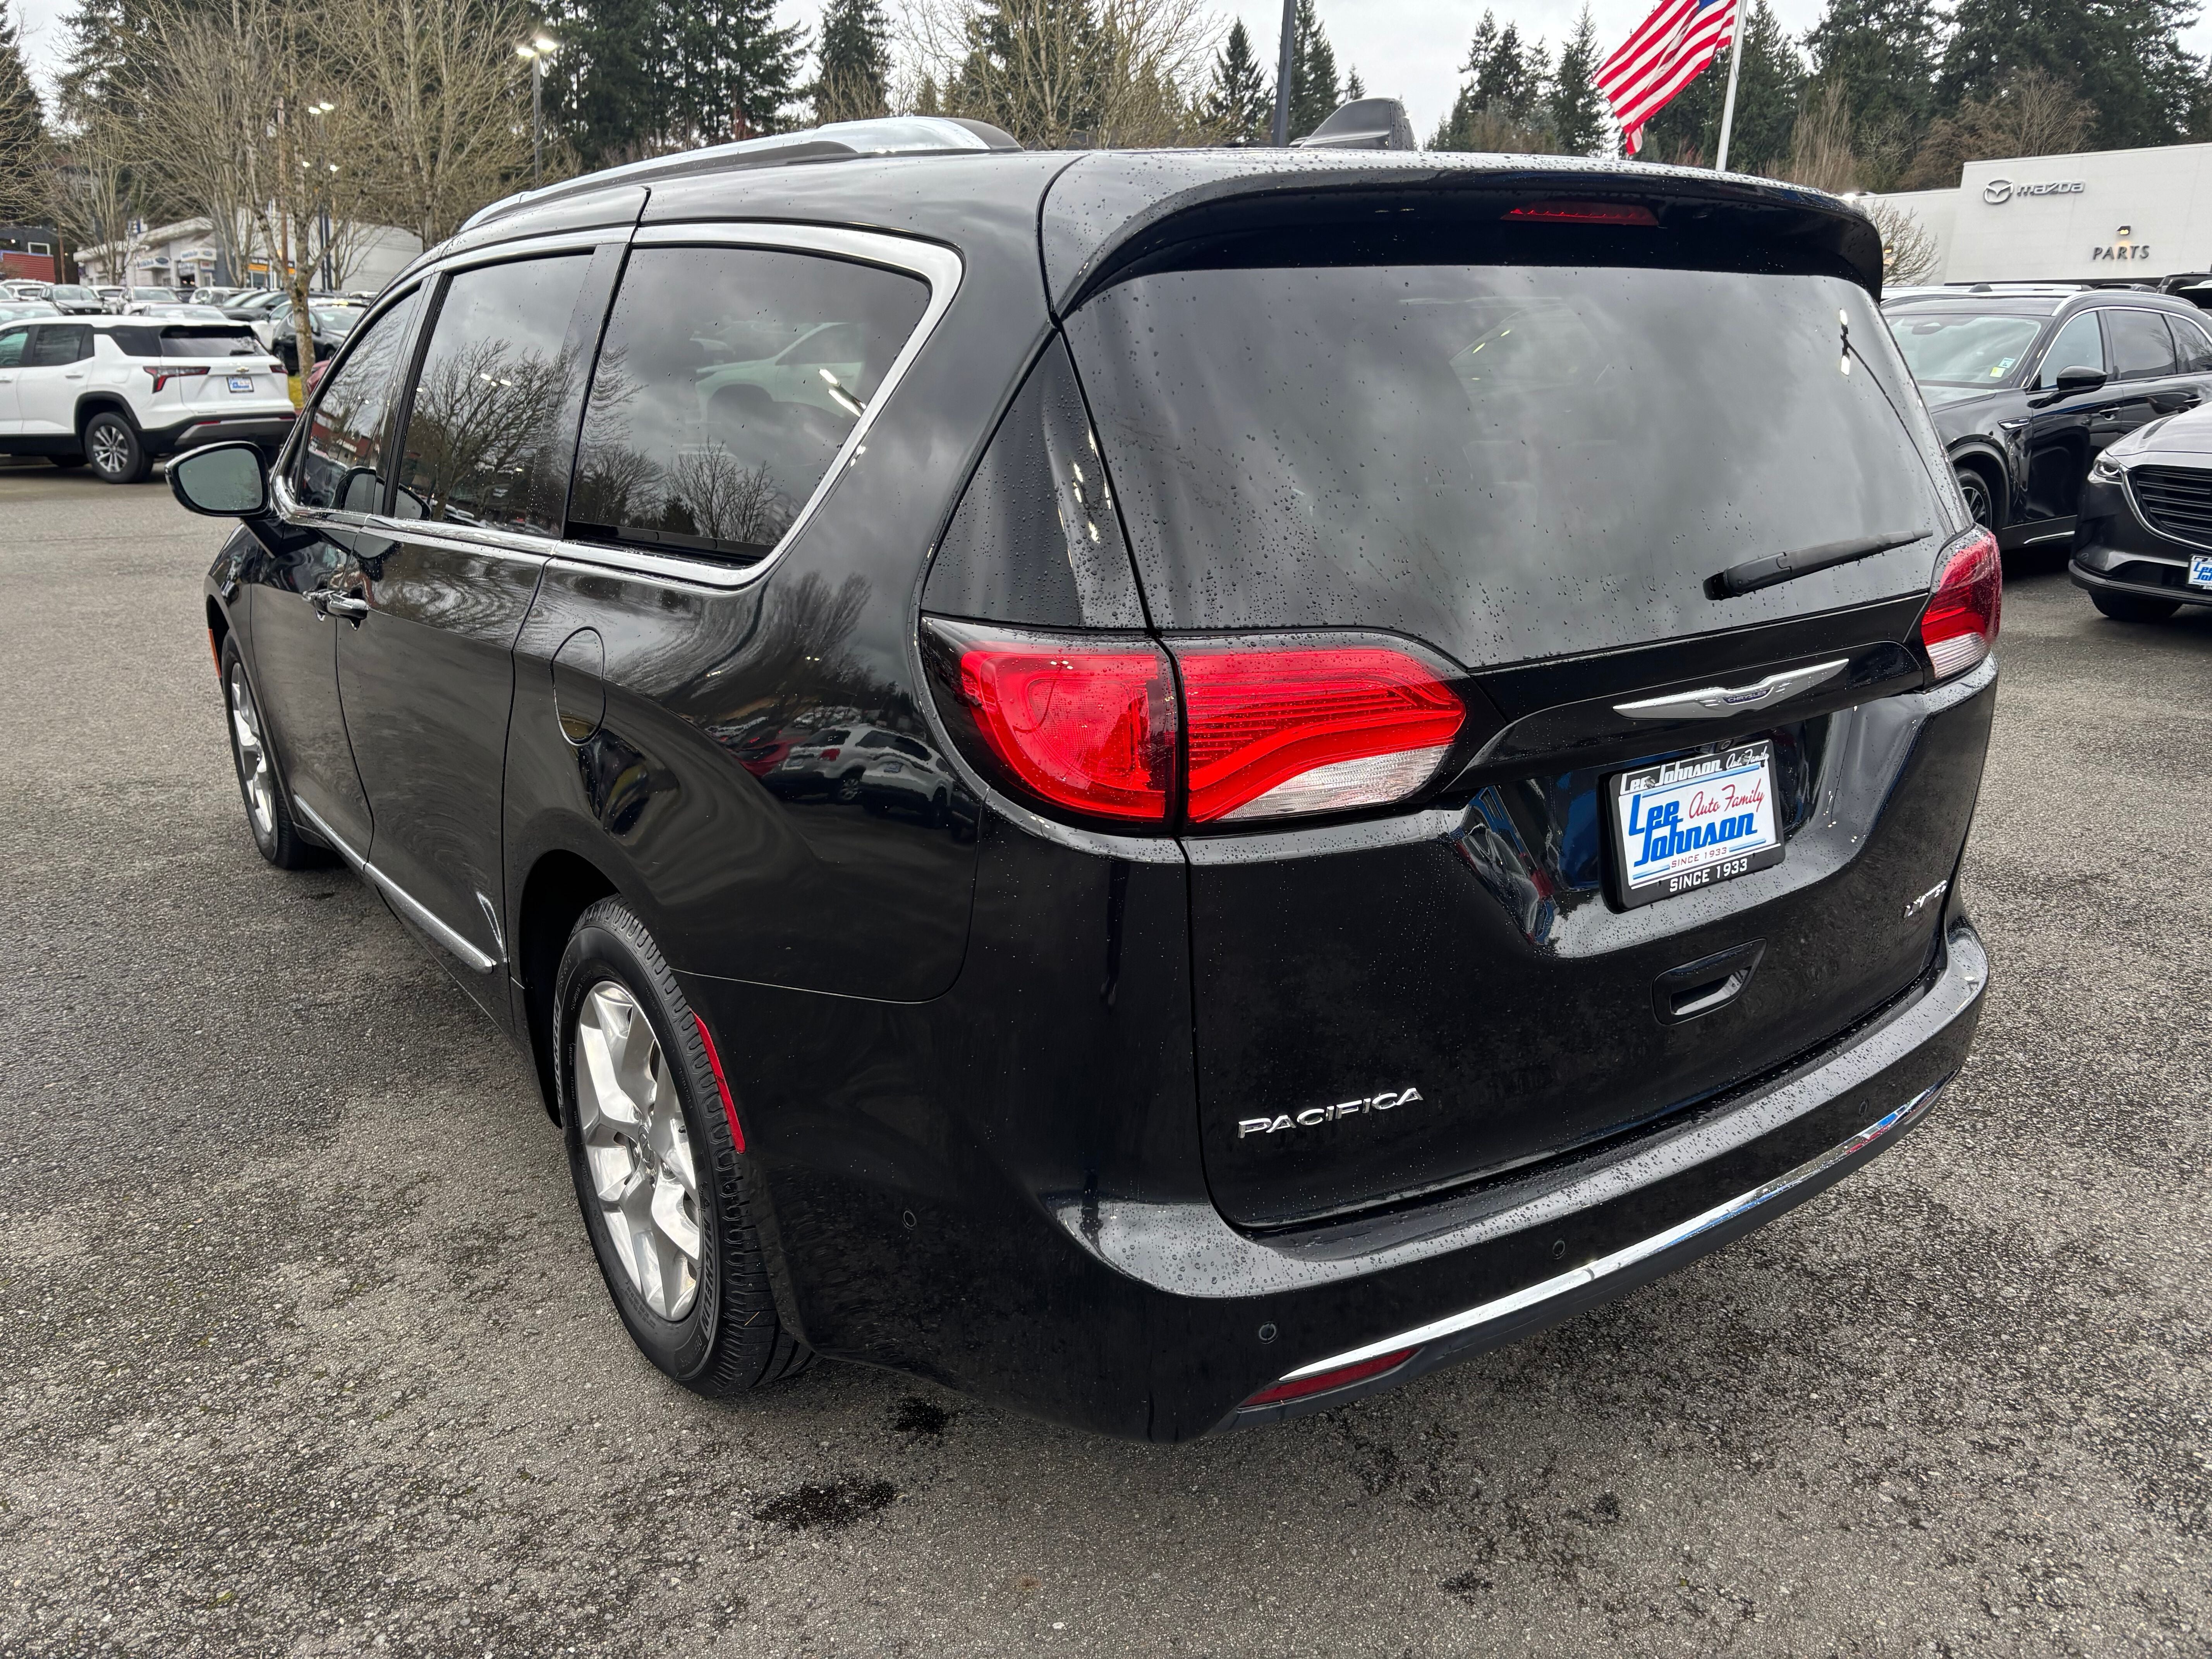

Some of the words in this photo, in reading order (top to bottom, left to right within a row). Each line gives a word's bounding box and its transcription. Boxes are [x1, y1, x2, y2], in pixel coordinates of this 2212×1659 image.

[2093, 245, 2150, 261] PARTS
[1728, 690, 1767, 702] CHRYSLER
[1654, 761, 1723, 787] Johnson
[1726, 753, 1747, 769] Aut
[1628, 794, 1683, 836] Lee
[1689, 791, 1721, 819] Auto
[1721, 778, 1765, 812] Family
[1634, 812, 1758, 867] Johnson
[1671, 854, 1699, 868] SINCE
[1704, 847, 1727, 859] 1933
[1669, 868, 1710, 892] SINCE
[1716, 858, 1747, 879] 1933
[1237, 1087, 1424, 1139] PACIFICA
[701, 1216, 713, 1331] MICHELIN
